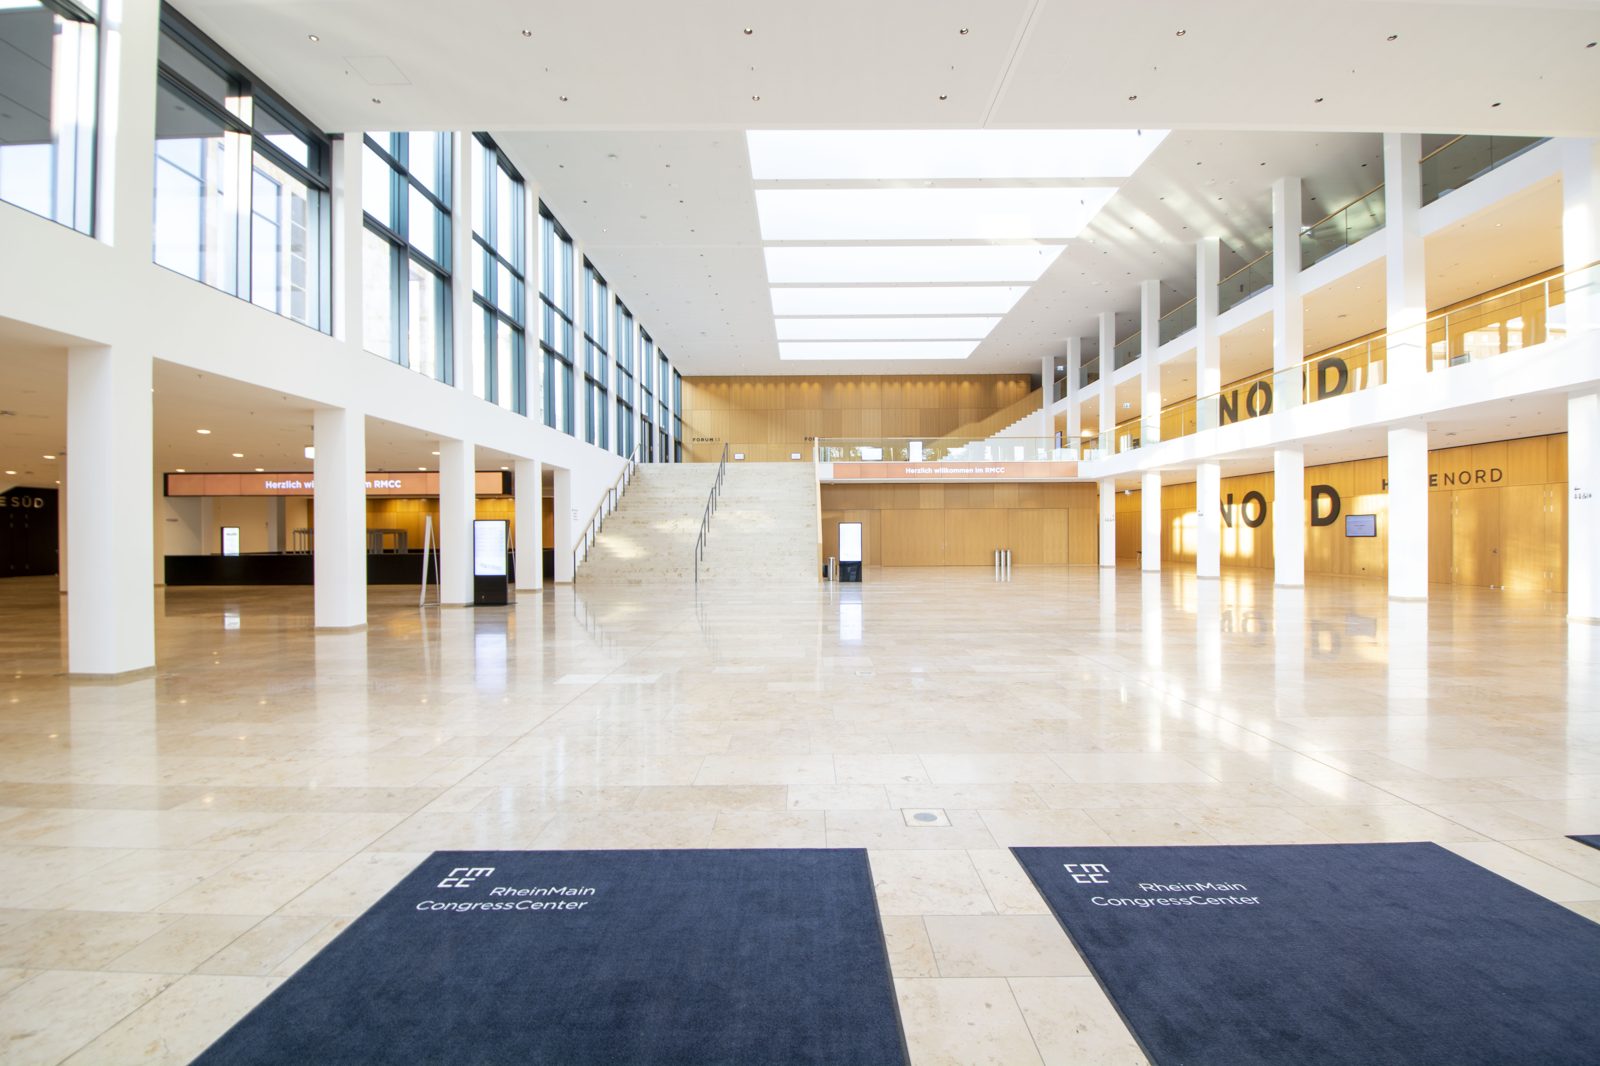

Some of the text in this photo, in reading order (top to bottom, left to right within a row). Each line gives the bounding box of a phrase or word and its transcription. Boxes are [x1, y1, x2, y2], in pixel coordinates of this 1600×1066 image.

[1220, 356, 1349, 427] NOD
[1444, 468, 1503, 486] NORD
[265, 480, 302, 489] Herzlich
[374, 480, 402, 488] RMCC
[11, 495, 44, 508] SÜD
[1220, 484, 1341, 528] NOD
[489, 886, 596, 897] RheinMain
[1139, 882, 1248, 892] RheinMain
[416, 899, 588, 912] CongressCenter
[1091, 895, 1260, 908] CongressCenter
